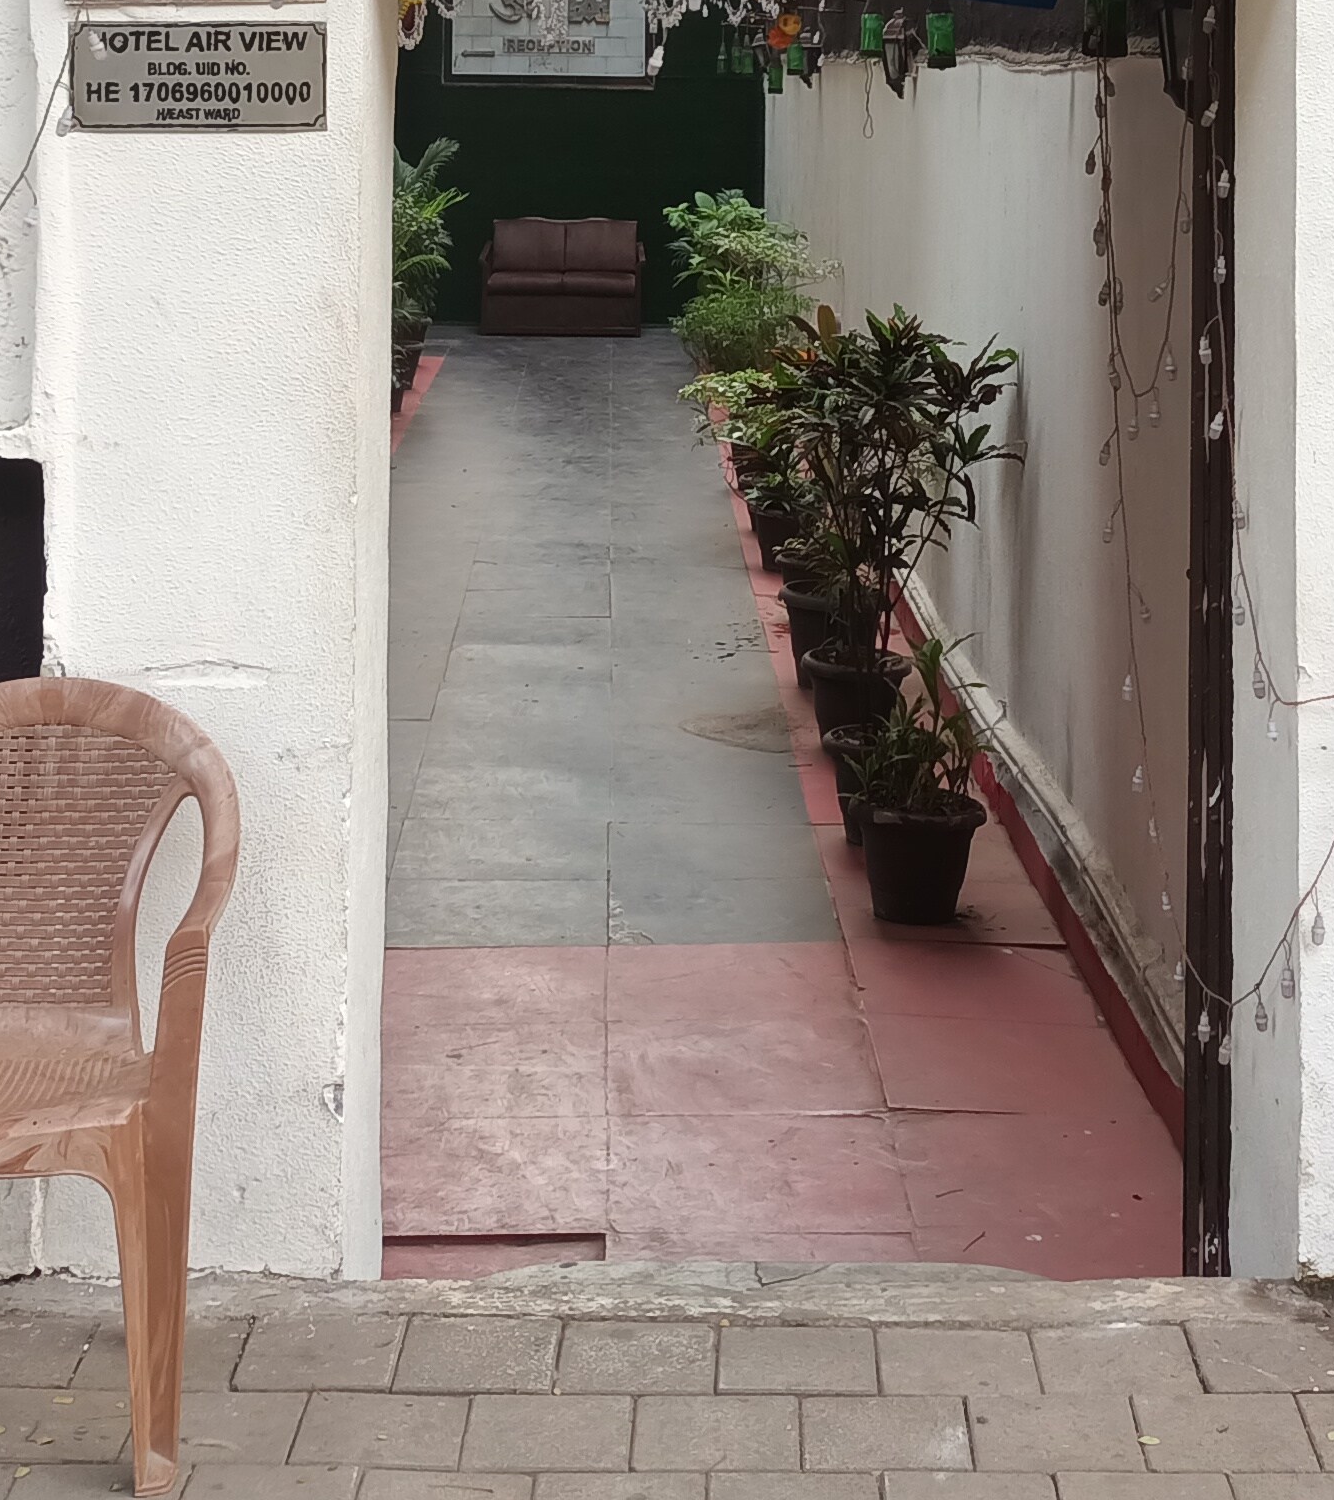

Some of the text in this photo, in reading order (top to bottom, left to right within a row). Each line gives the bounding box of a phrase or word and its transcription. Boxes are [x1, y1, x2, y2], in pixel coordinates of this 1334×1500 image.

[185, 30, 232, 53] AIR
[238, 30, 308, 52] VIEW
[147, 59, 251, 77] BLDG. UID NO.
[86, 81, 311, 105] HE 1706960010000
[203, 107, 241, 122] WARD
